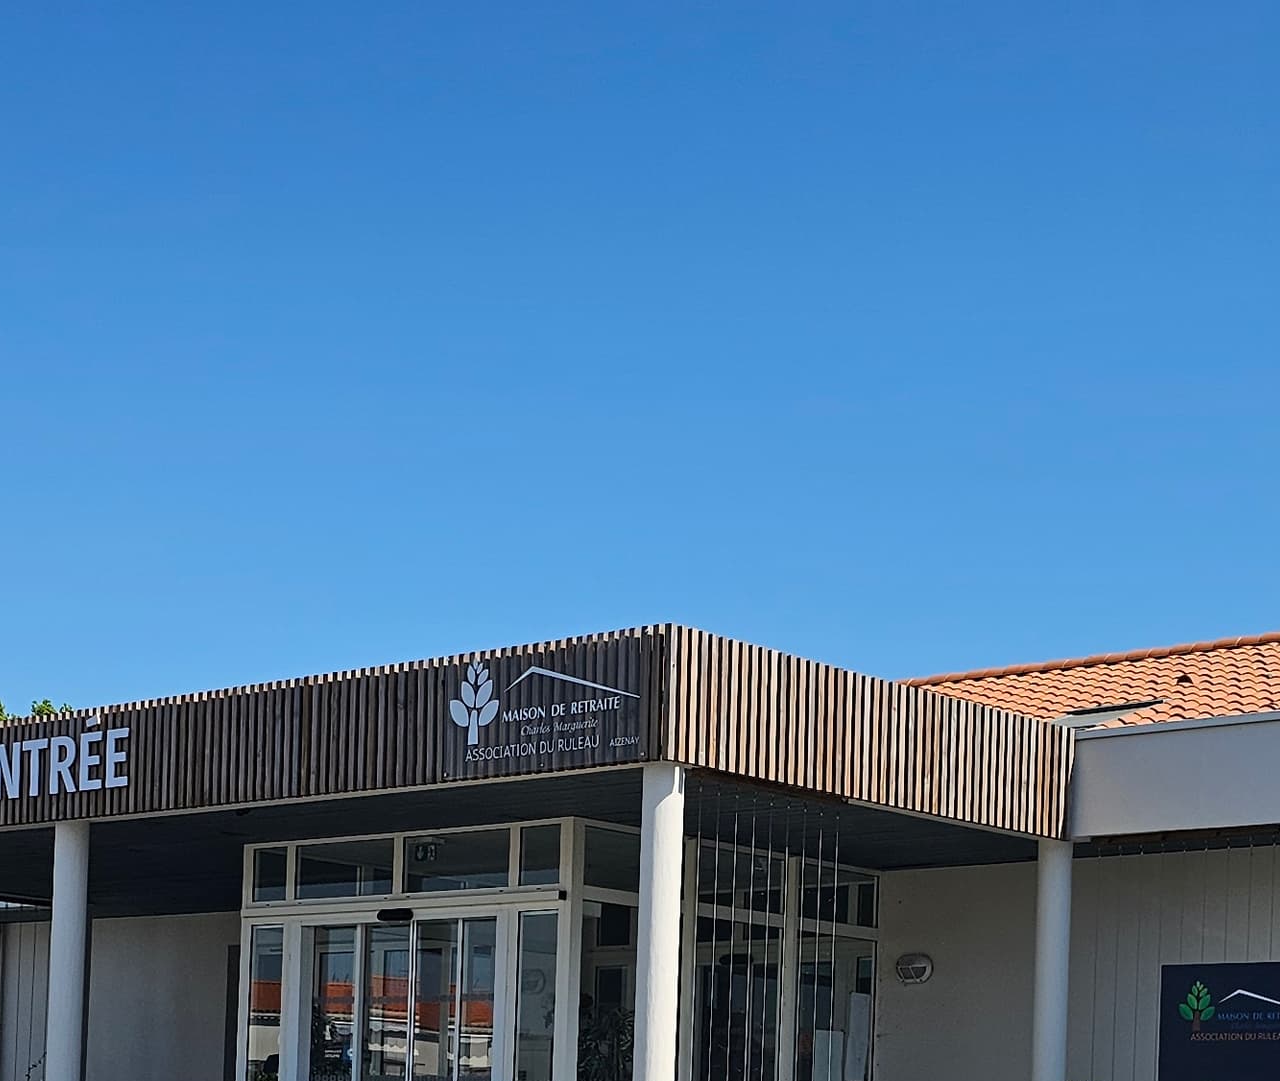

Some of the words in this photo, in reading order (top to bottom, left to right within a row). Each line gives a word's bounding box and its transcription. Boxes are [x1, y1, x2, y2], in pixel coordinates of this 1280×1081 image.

[502, 706, 546, 722] MAISON
[551, 703, 566, 717] DE
[570, 696, 621, 713] RETRAITE
[465, 742, 537, 762] ASSOCIATION
[540, 739, 556, 754] DU
[559, 734, 600, 752] RULEAU
[1191, 1032, 1243, 1041] ASSOCIATION
